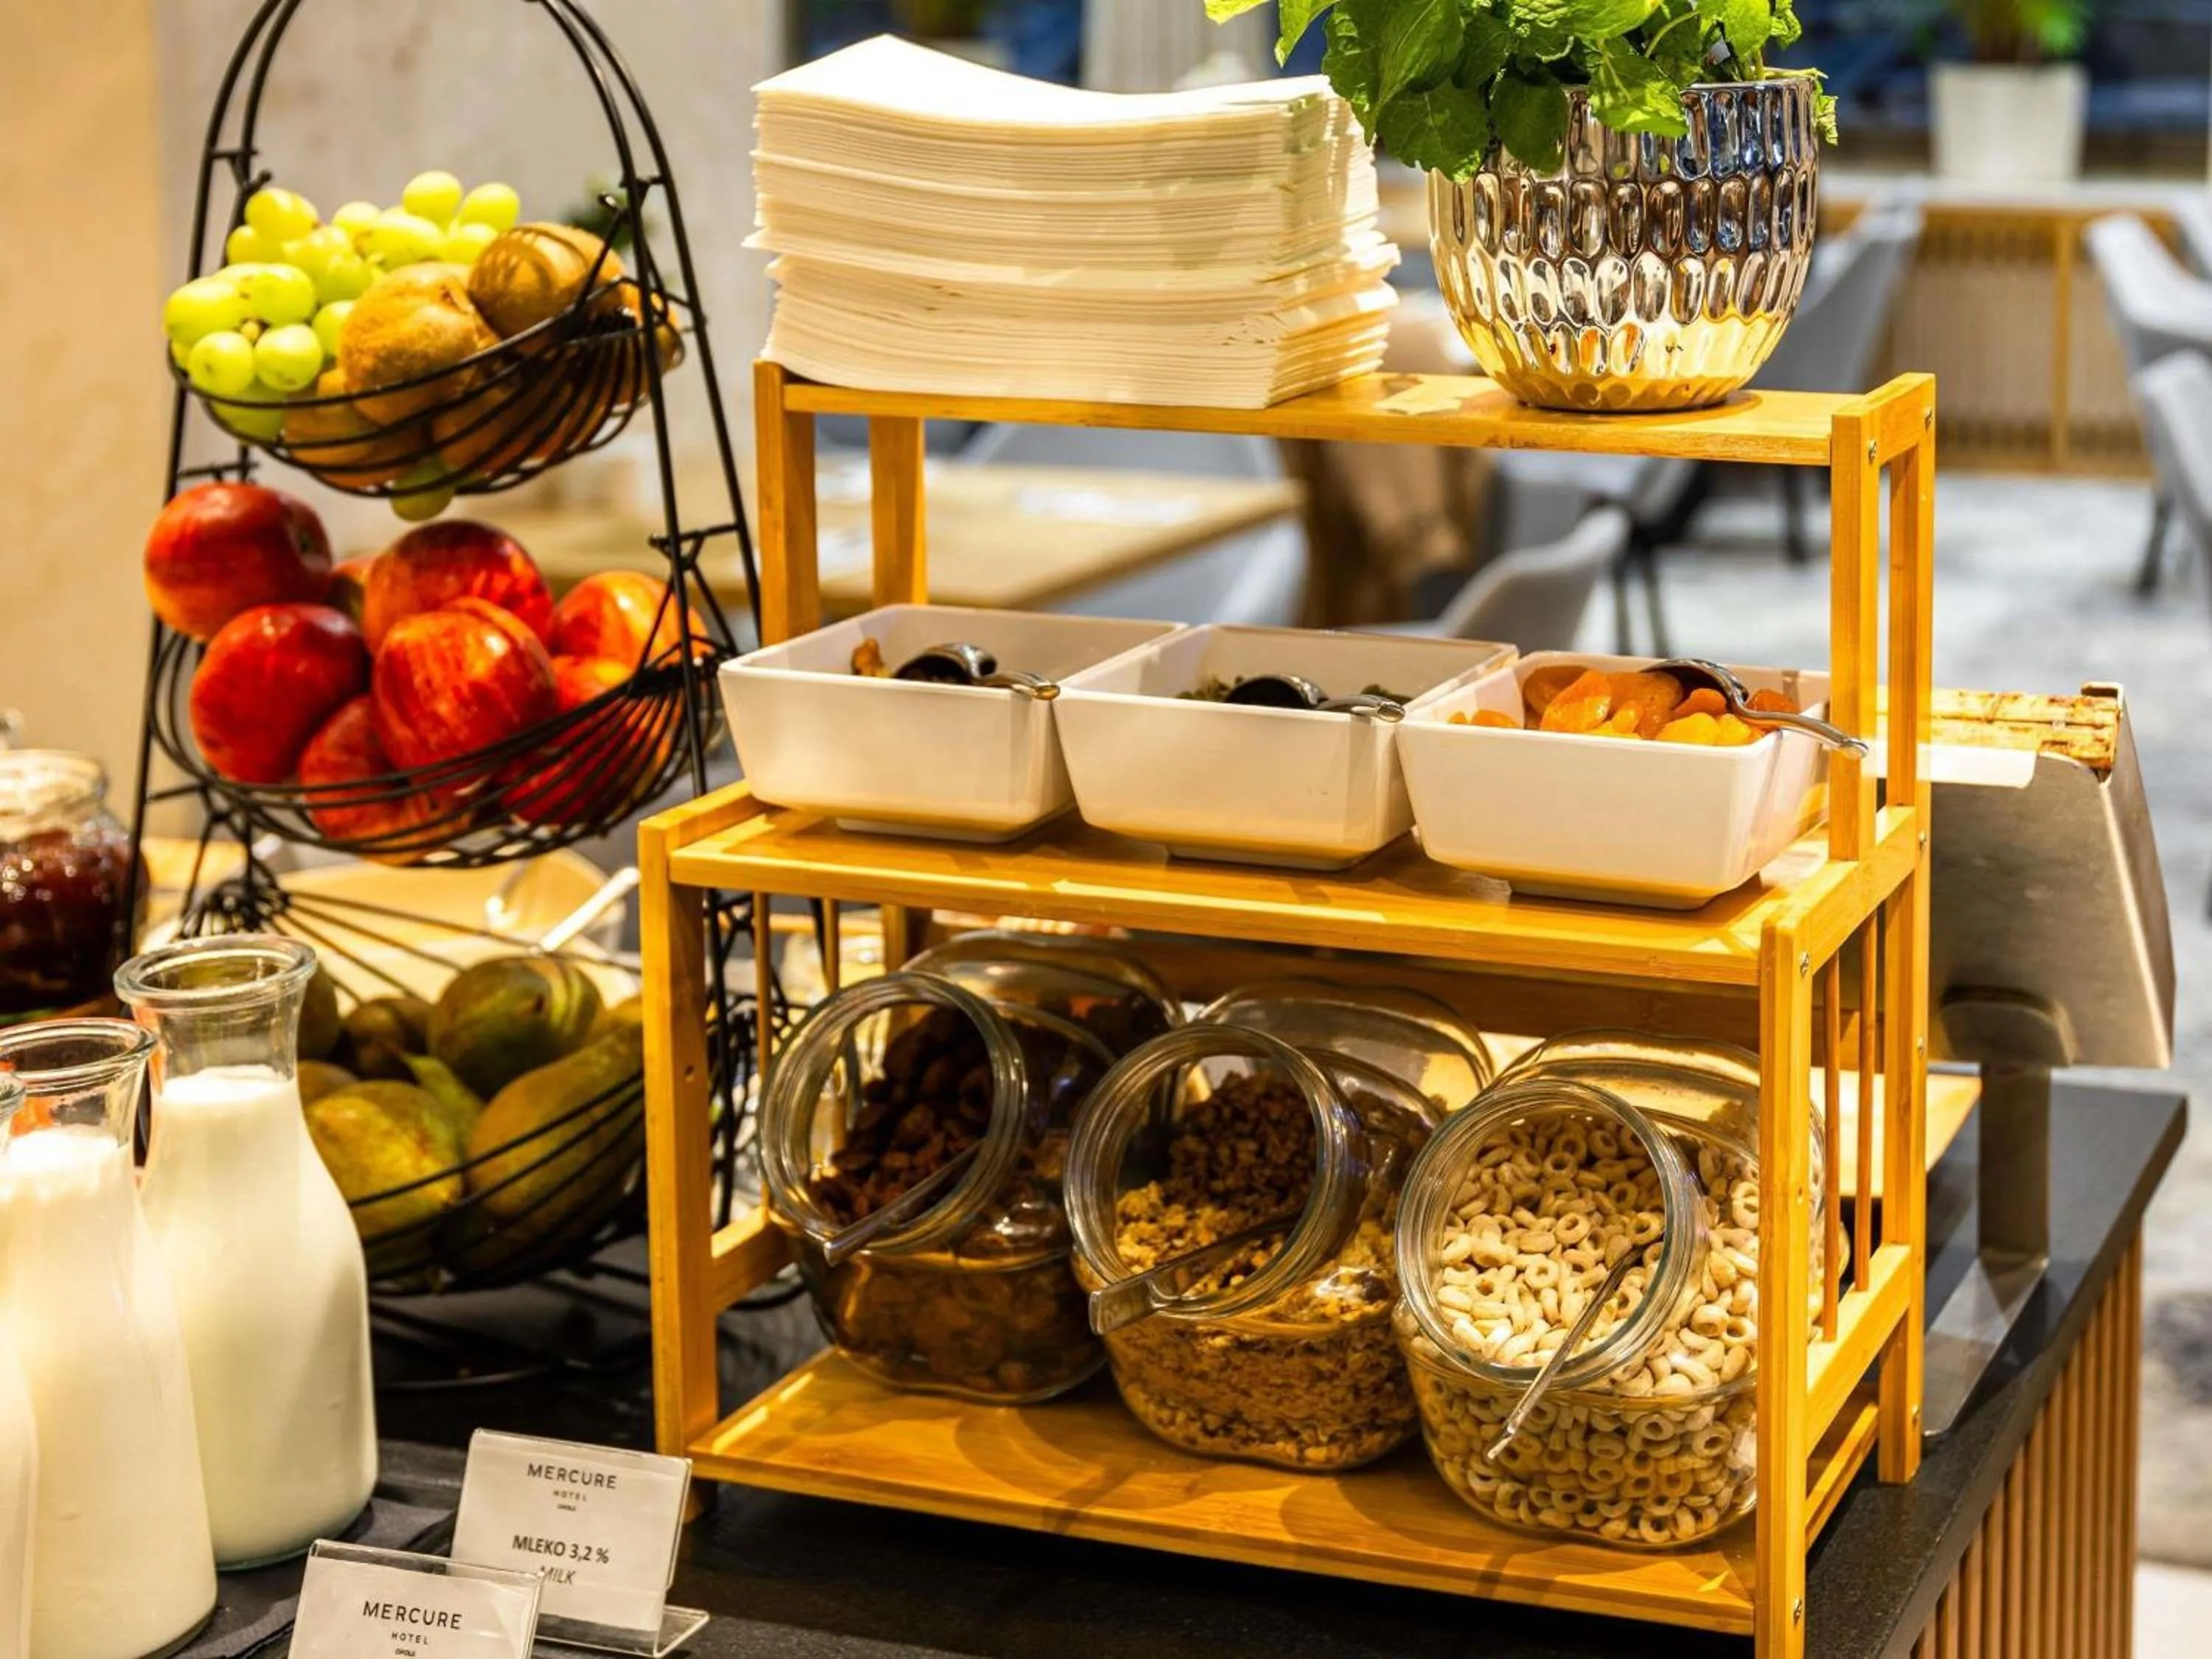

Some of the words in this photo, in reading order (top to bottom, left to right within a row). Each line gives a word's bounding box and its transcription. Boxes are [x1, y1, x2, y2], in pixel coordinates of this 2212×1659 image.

[526, 1462, 617, 1489] MERCURE
[553, 1489, 587, 1501] HOTEL
[512, 1534, 566, 1557] MLEKO
[568, 1543, 592, 1562] 3,2
[596, 1547, 609, 1564] %
[362, 1600, 462, 1630] MERCURE
[391, 1632, 428, 1646] HOTEL
